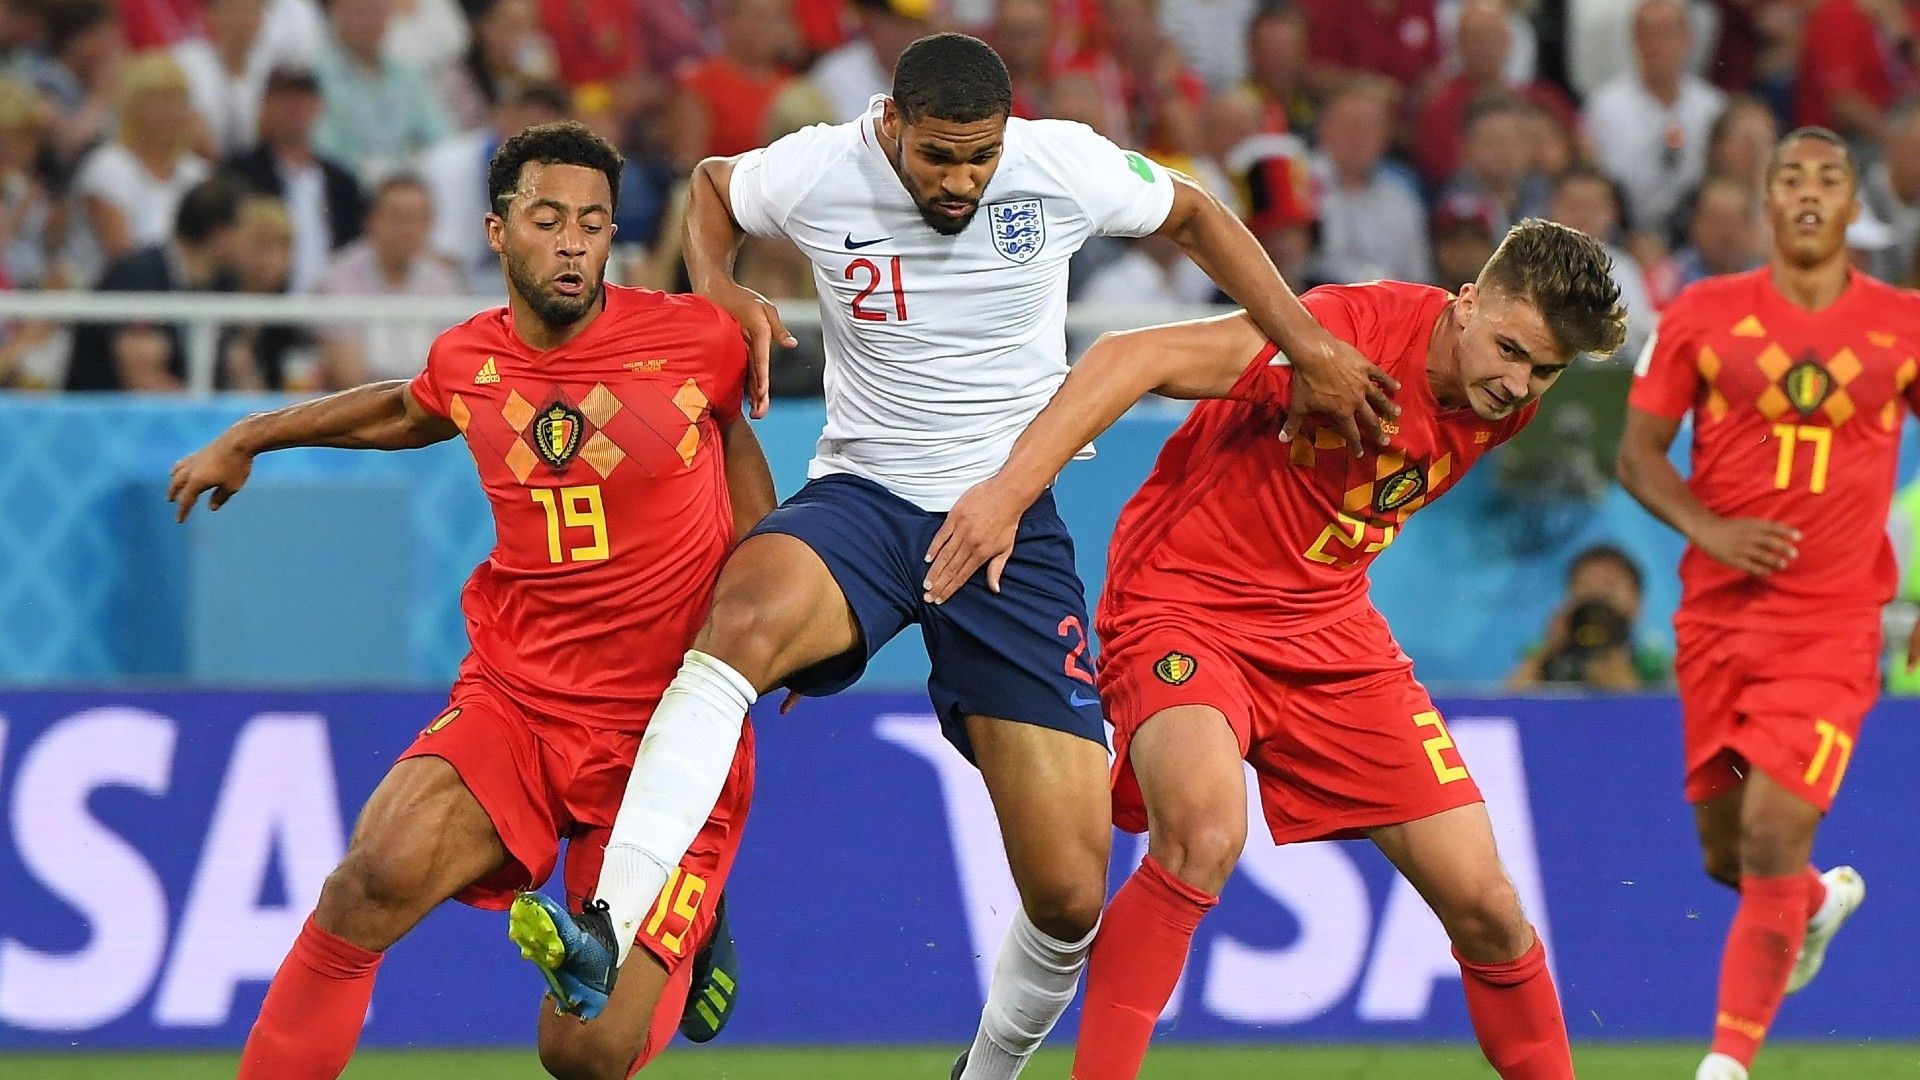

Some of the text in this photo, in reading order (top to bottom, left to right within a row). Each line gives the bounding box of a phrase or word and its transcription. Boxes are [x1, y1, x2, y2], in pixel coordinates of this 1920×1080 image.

[845, 256, 907, 322] 21
[474, 374, 500, 384] adidas
[1773, 424, 1832, 494] 17
[530, 485, 610, 563] 19
[1057, 615, 1094, 685] 2
[1804, 719, 1853, 798] 17
[0, 707, 372, 1030] SA
[645, 866, 707, 955] 19
